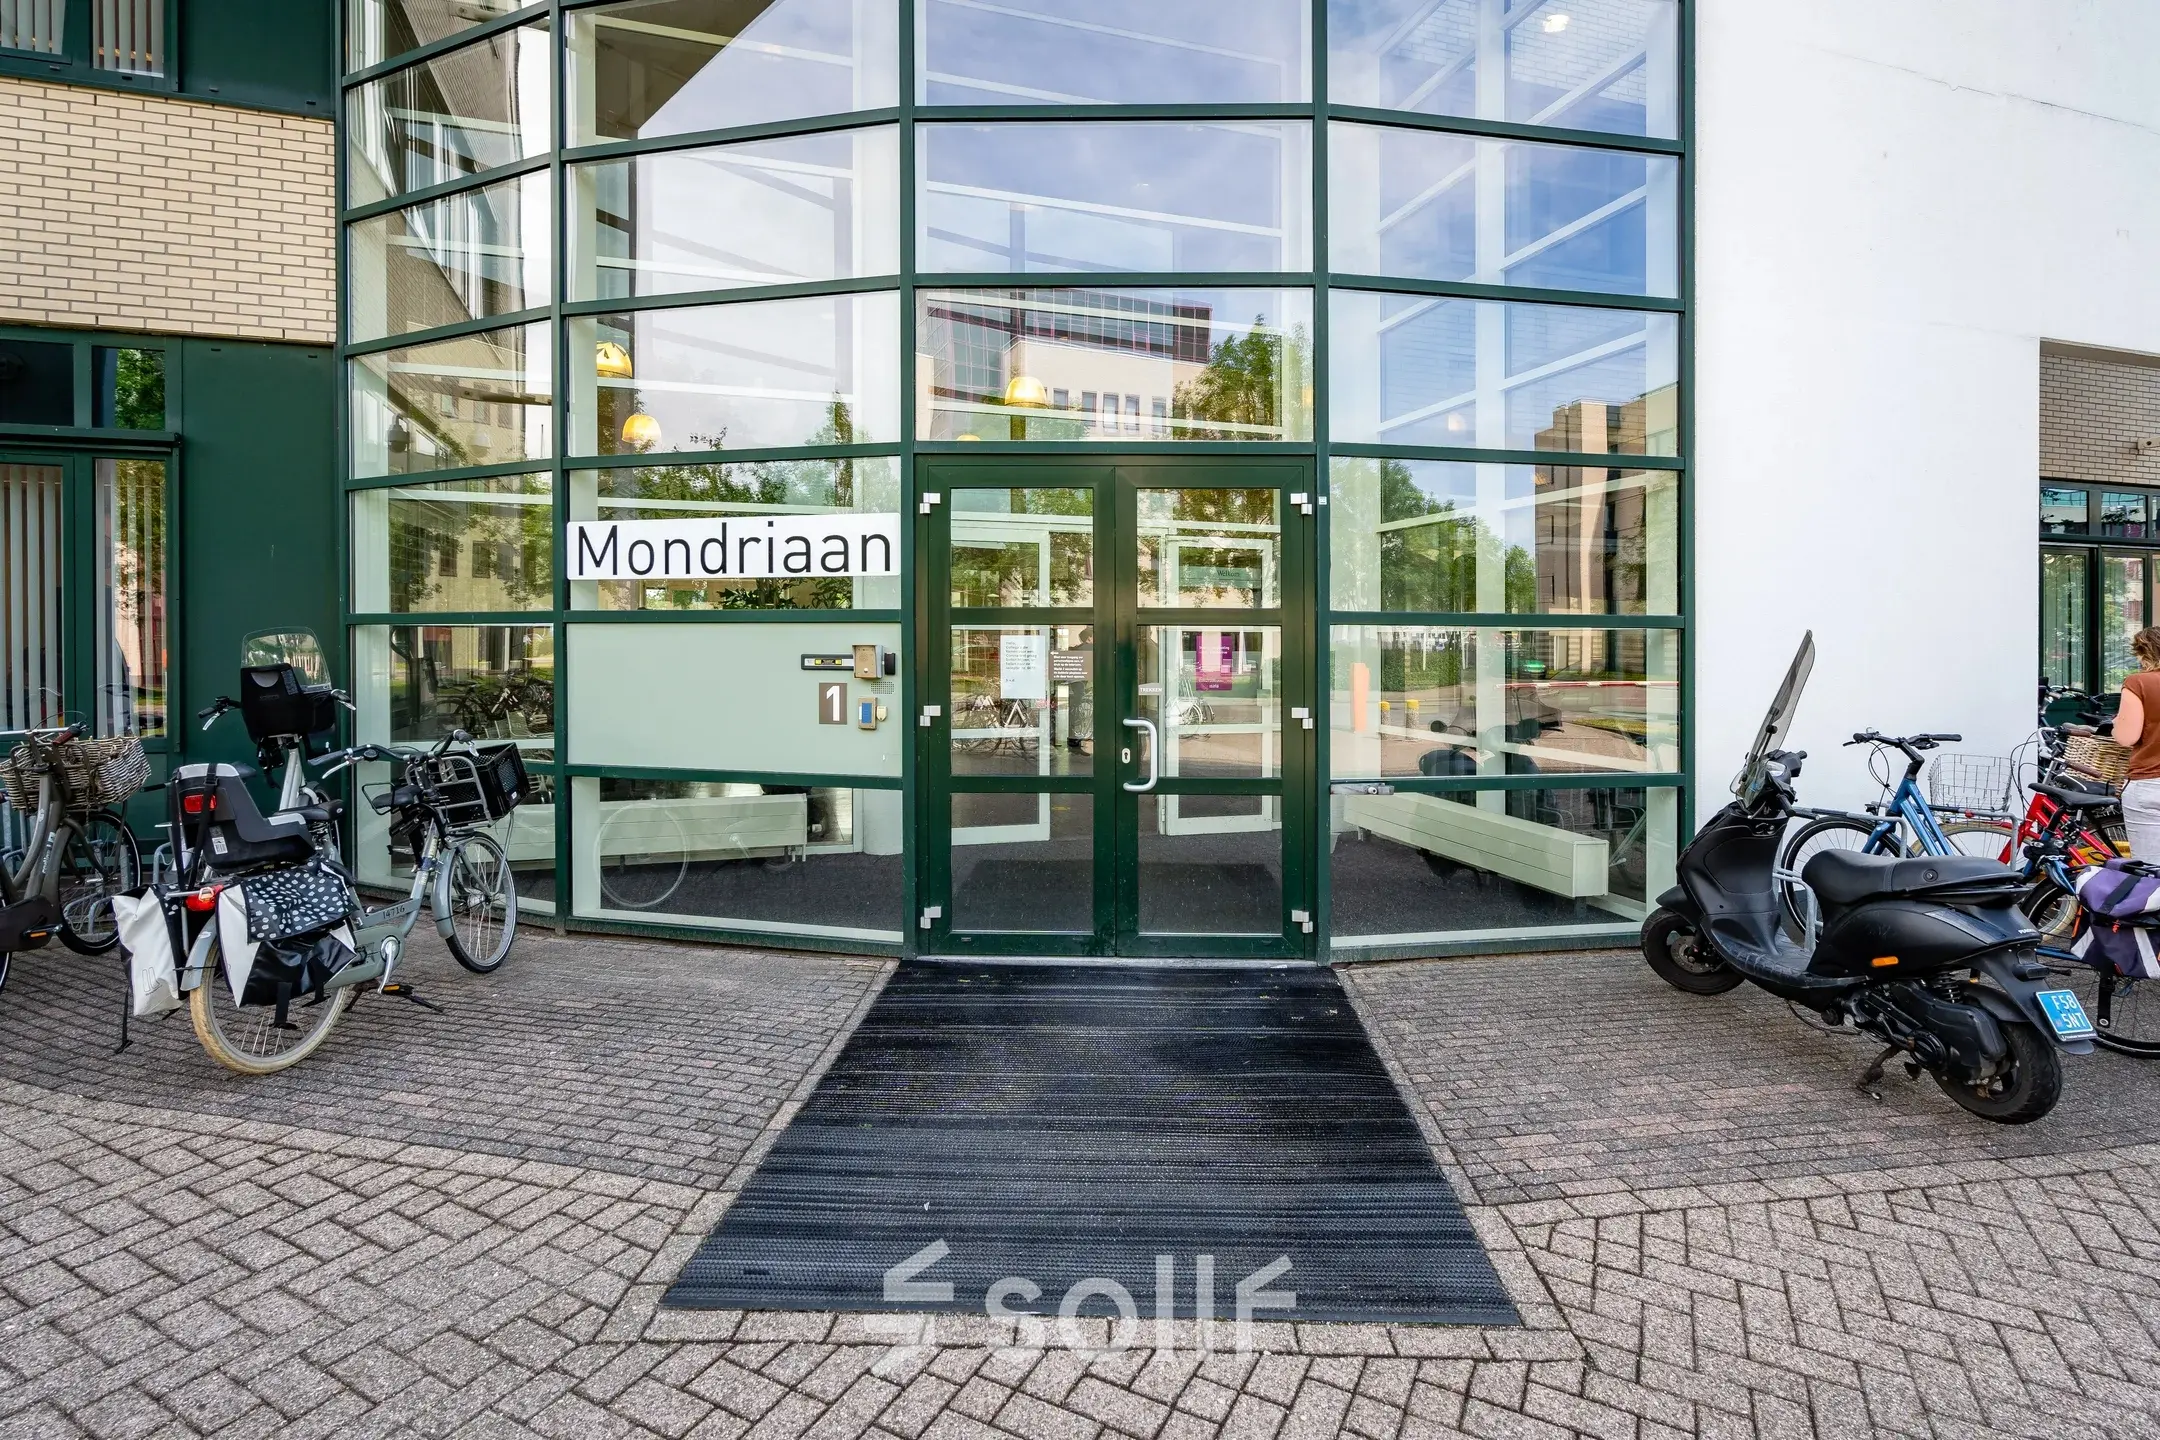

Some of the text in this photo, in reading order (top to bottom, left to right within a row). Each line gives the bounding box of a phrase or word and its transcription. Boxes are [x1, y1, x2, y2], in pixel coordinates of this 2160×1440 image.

[578, 520, 891, 575] Mondriaan
[826, 685, 840, 722] 1
[2051, 994, 2077, 1010] F58
[2061, 1012, 2086, 1028] 5NT
